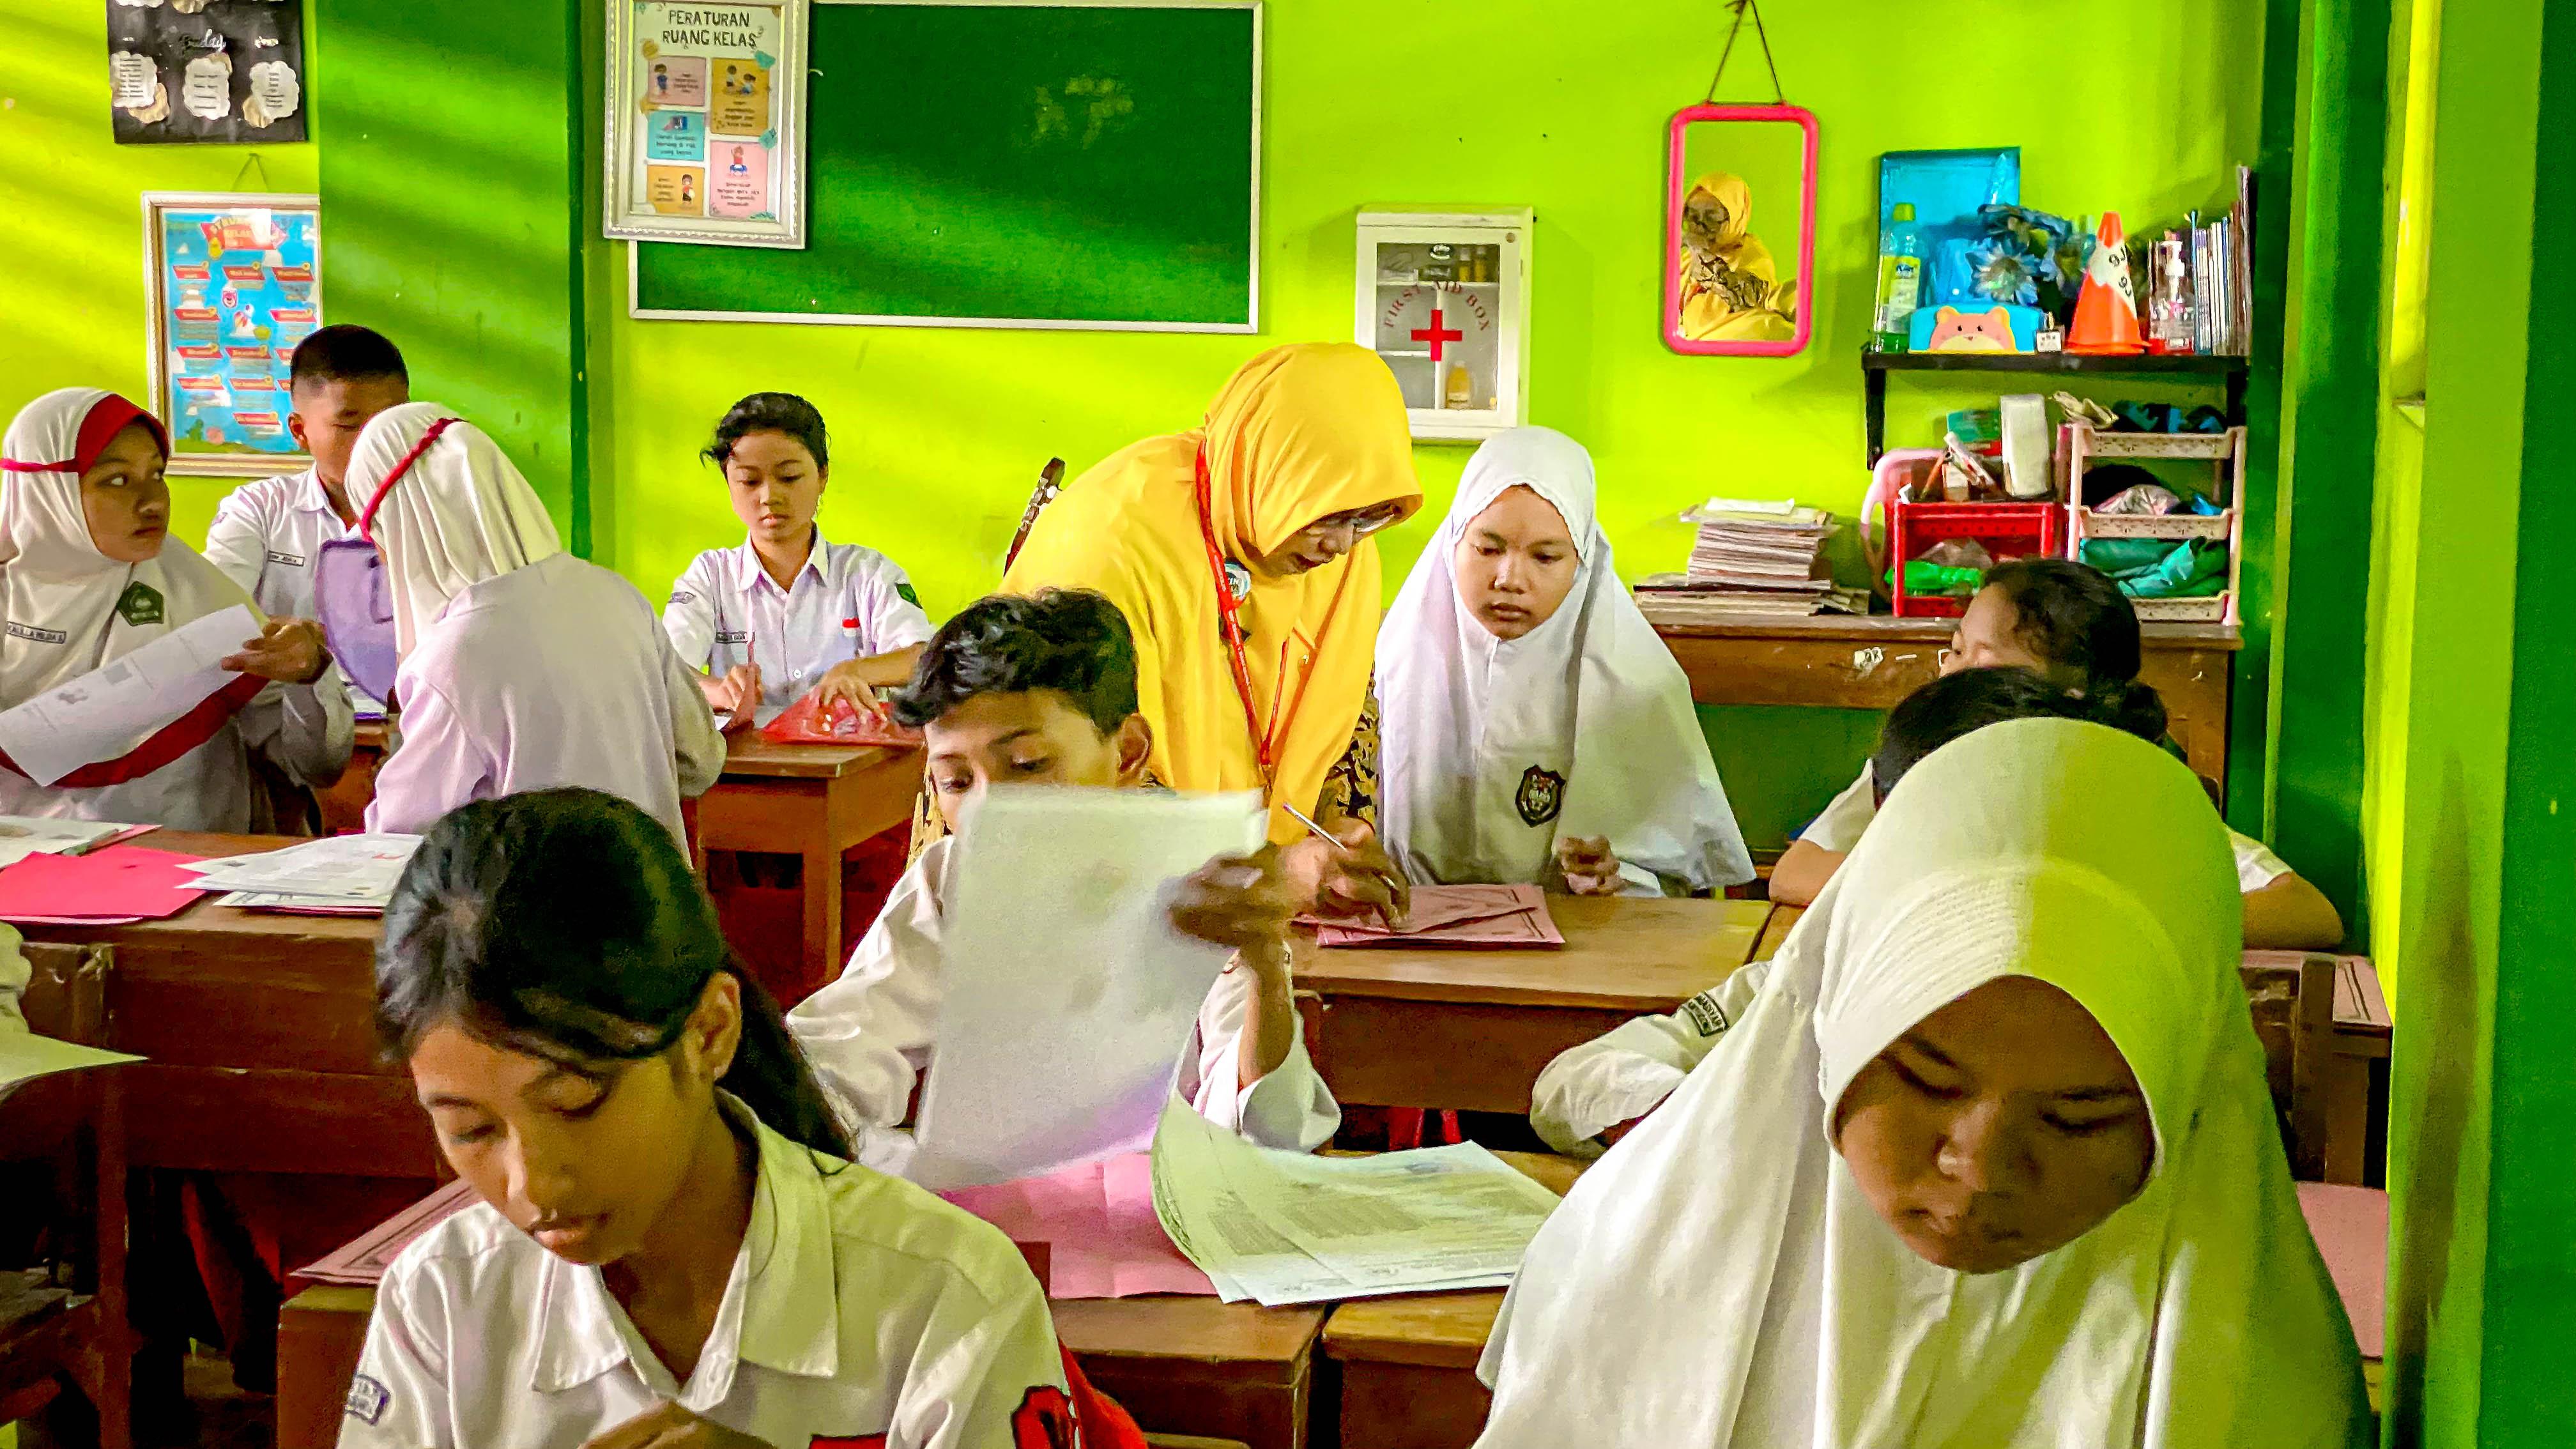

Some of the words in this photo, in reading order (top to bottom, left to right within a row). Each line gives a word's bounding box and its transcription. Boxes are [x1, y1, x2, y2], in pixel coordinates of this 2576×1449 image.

[668, 10, 750, 27] PERATURAN
[662, 29, 710, 46] RUANG
[713, 31, 757, 48] KELAS
[1384, 284, 1422, 328] FIRST
[1466, 294, 1490, 331] BOX
